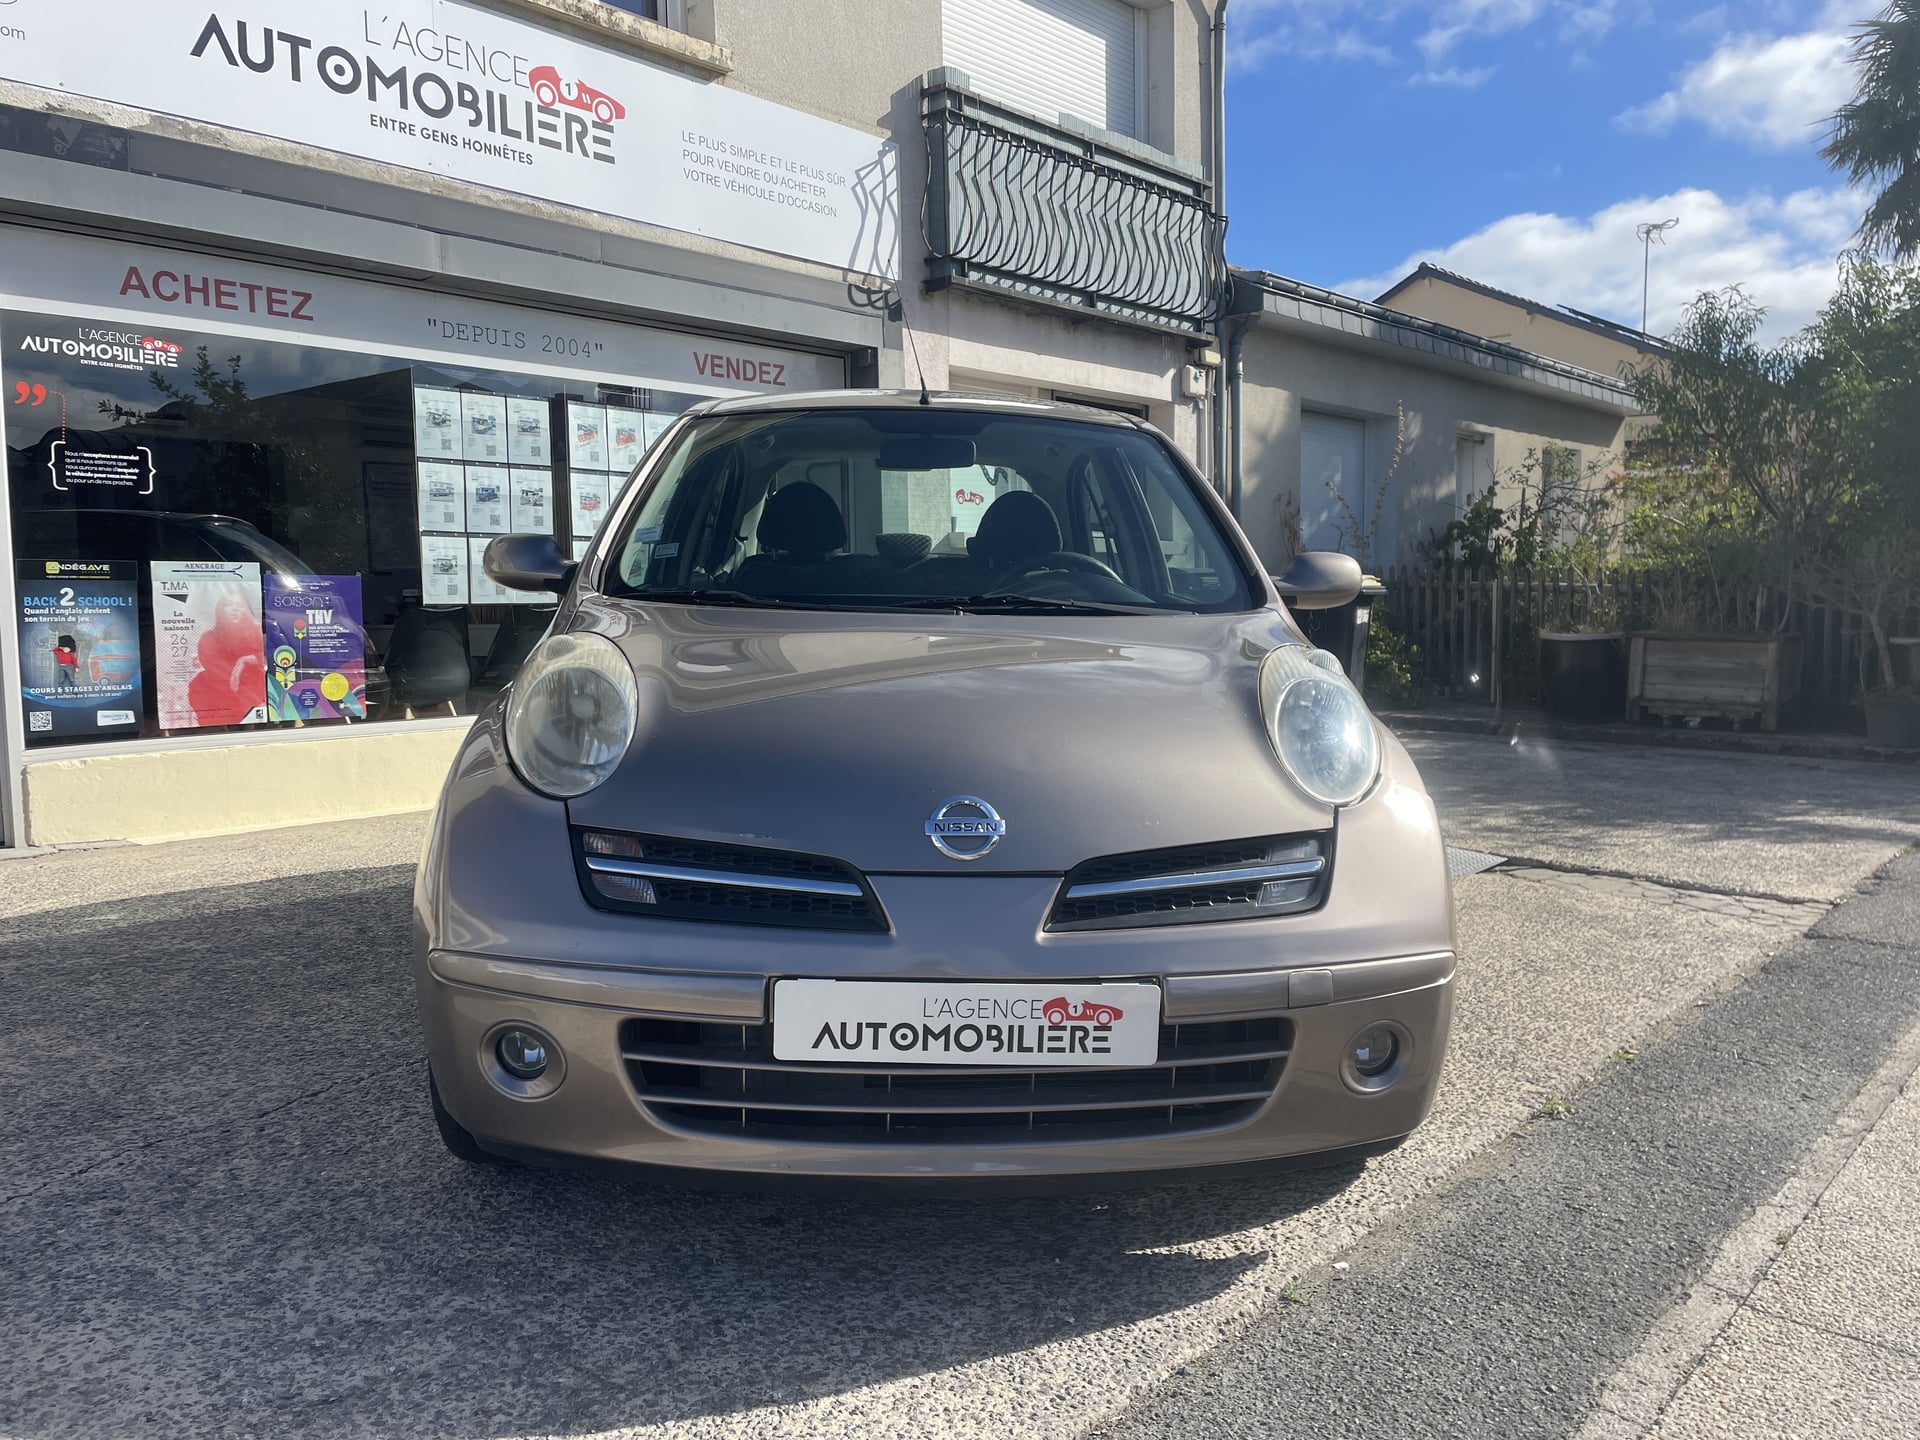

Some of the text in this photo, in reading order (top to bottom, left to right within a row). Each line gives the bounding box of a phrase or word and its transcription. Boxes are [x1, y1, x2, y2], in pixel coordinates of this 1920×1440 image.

[364, 10, 528, 88] L'AGENCE
[370, 114, 534, 165] ENTRE GENS HONNÊTES
[682, 130, 847, 188] LE PLUS SIMPLE ET LE PLUS SÛR
[682, 149, 827, 199] POUR VENDRE OU ACHETER
[683, 167, 837, 218] VOTRE VÉHICULE D'OCCASION
[119, 266, 314, 321] ACHETEZ
[78, 327, 142, 346] L'AGENCE
[80, 359, 98, 367] ENTRE
[99, 361, 113, 369] GENS
[692, 351, 786, 387] VENDEZ
[160, 581, 189, 591] T.MA
[23, 596, 57, 606] BACK
[59, 587, 75, 606] 2
[78, 597, 126, 606] SCHOOL
[24, 607, 49, 615] Quand
[50, 607, 83, 616] l'anglais
[40, 615, 66, 623] terrain
[170, 634, 188, 645] 26
[171, 646, 188, 658] 27
[94, 684, 133, 692] D'ANGLAIS
[933, 822, 998, 834] NISSAN
[923, 997, 1043, 1020] L'AGENCE
